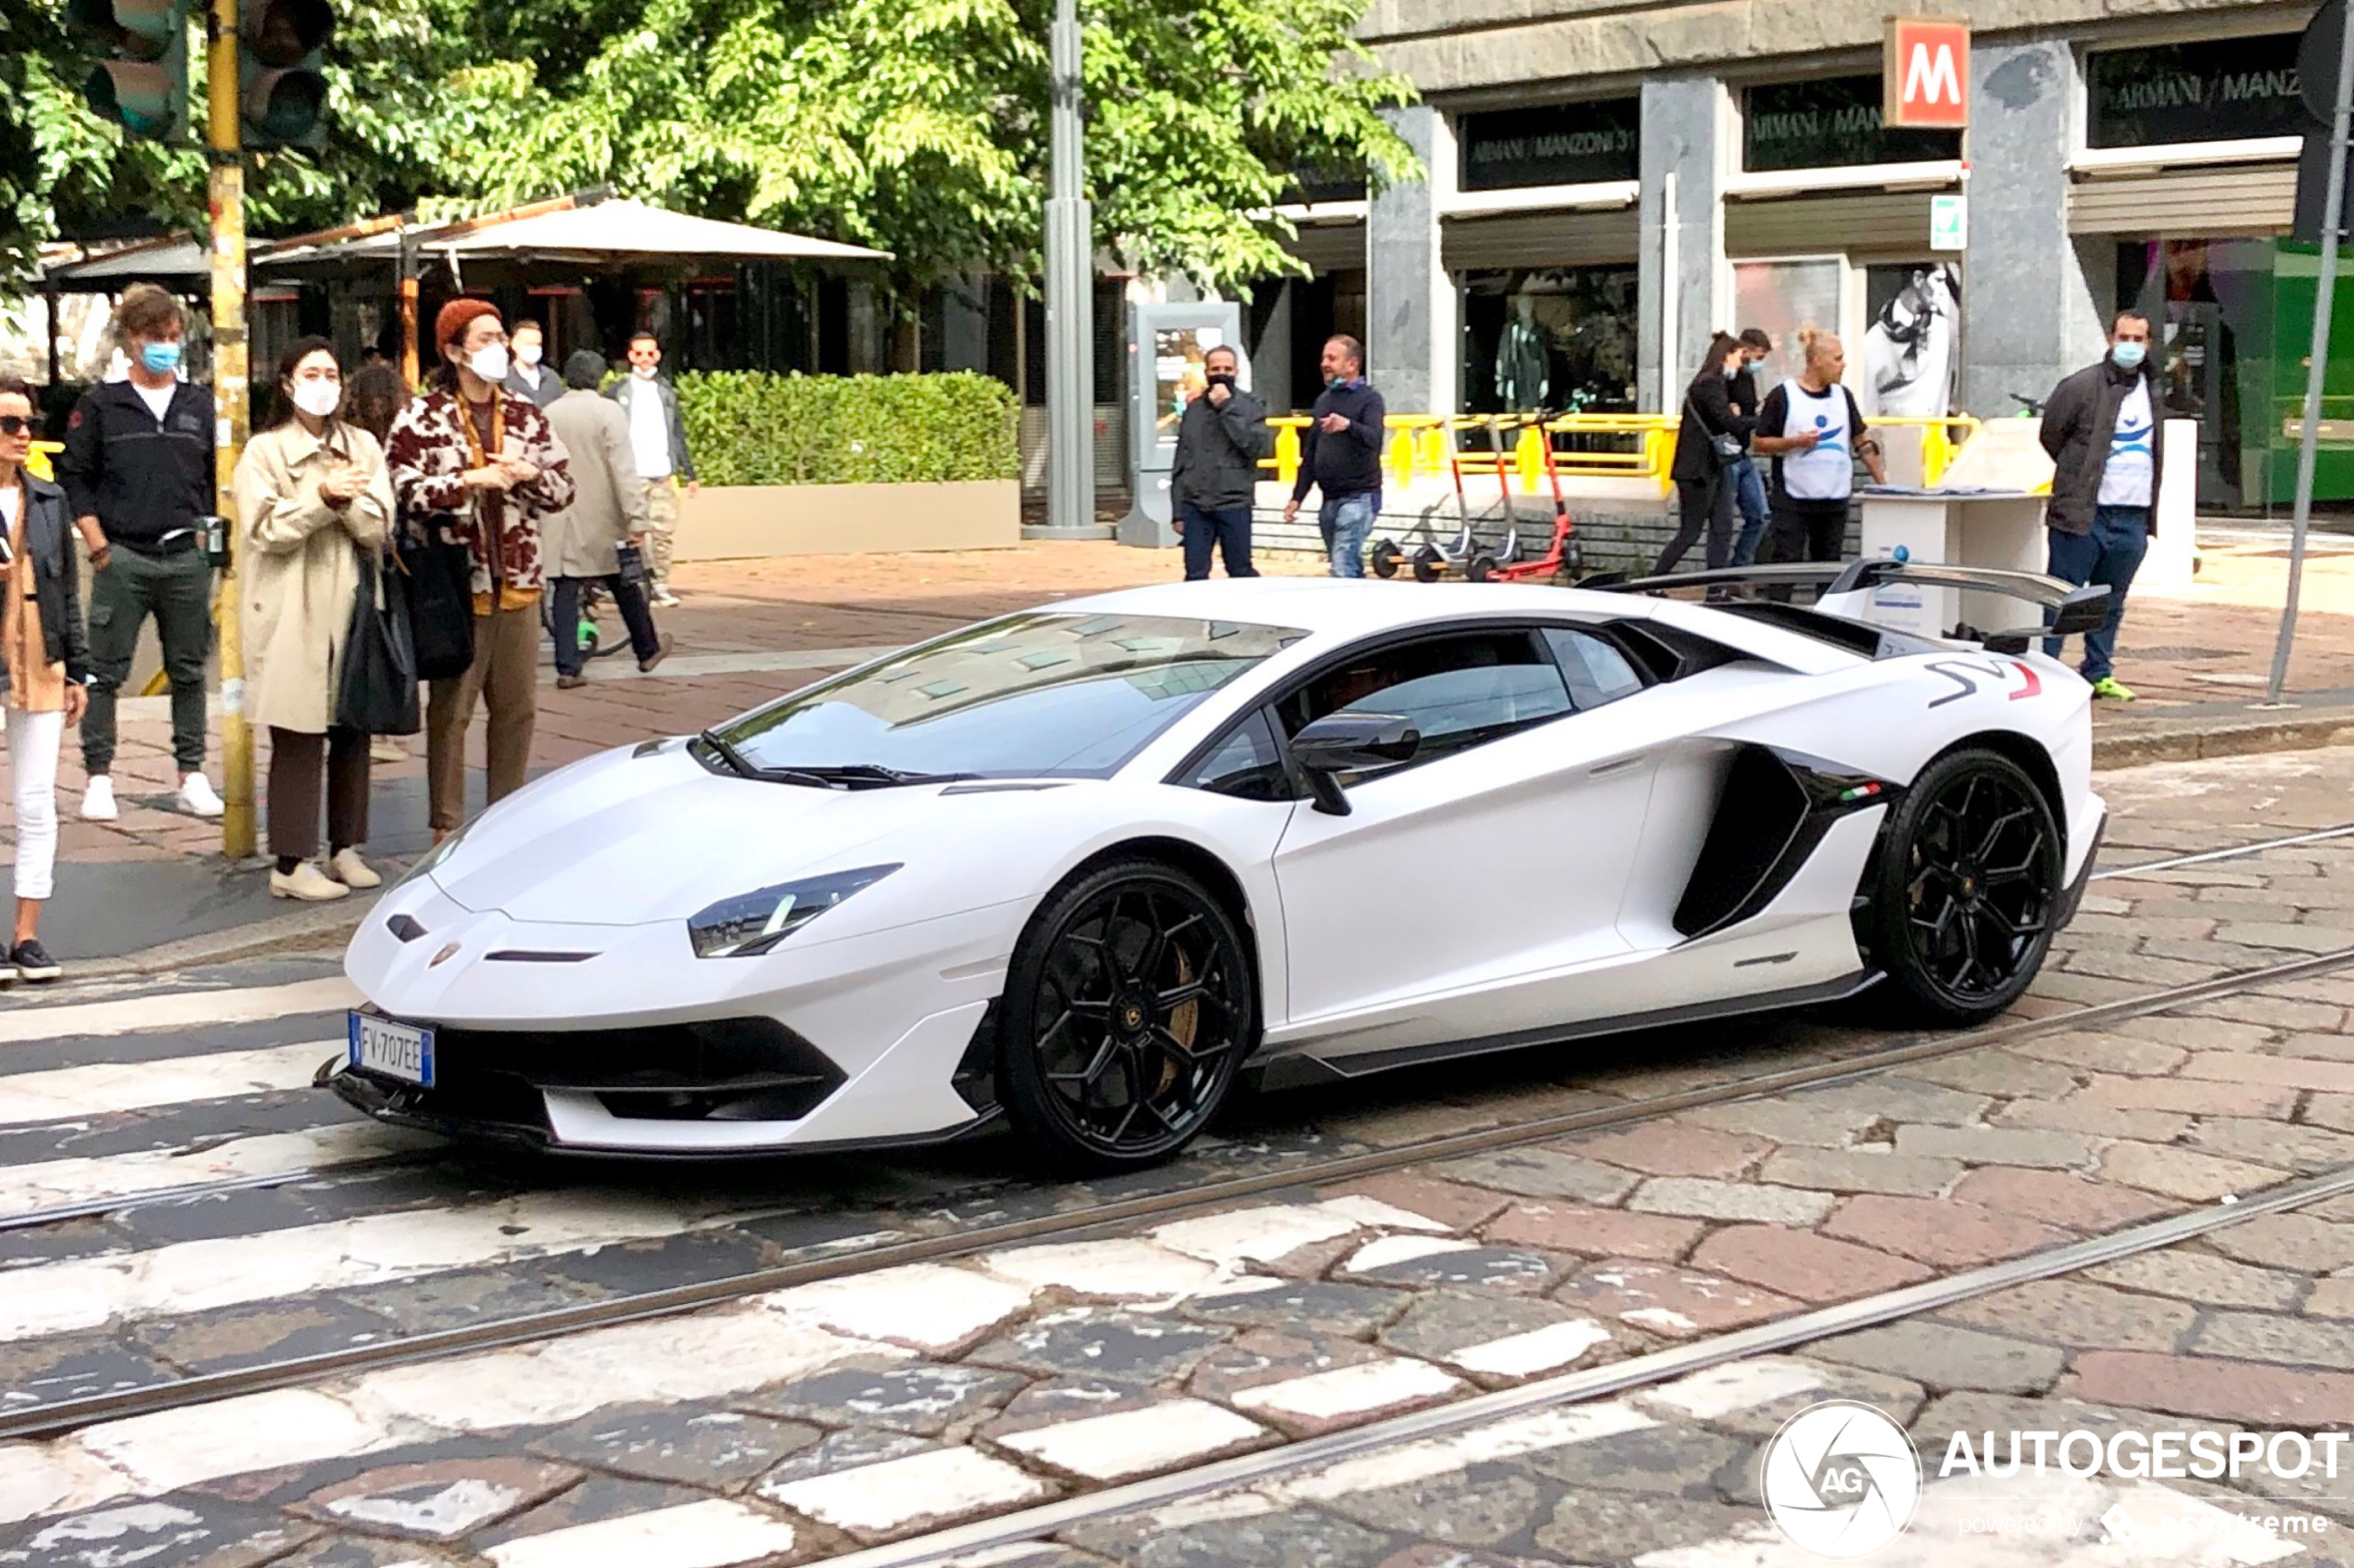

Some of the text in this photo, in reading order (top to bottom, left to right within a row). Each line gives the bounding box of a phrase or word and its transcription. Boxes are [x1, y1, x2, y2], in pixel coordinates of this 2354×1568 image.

[1904, 43, 1961, 105] M
[2223, 68, 2302, 101] MANZ
[1834, 105, 1885, 133] MAN
